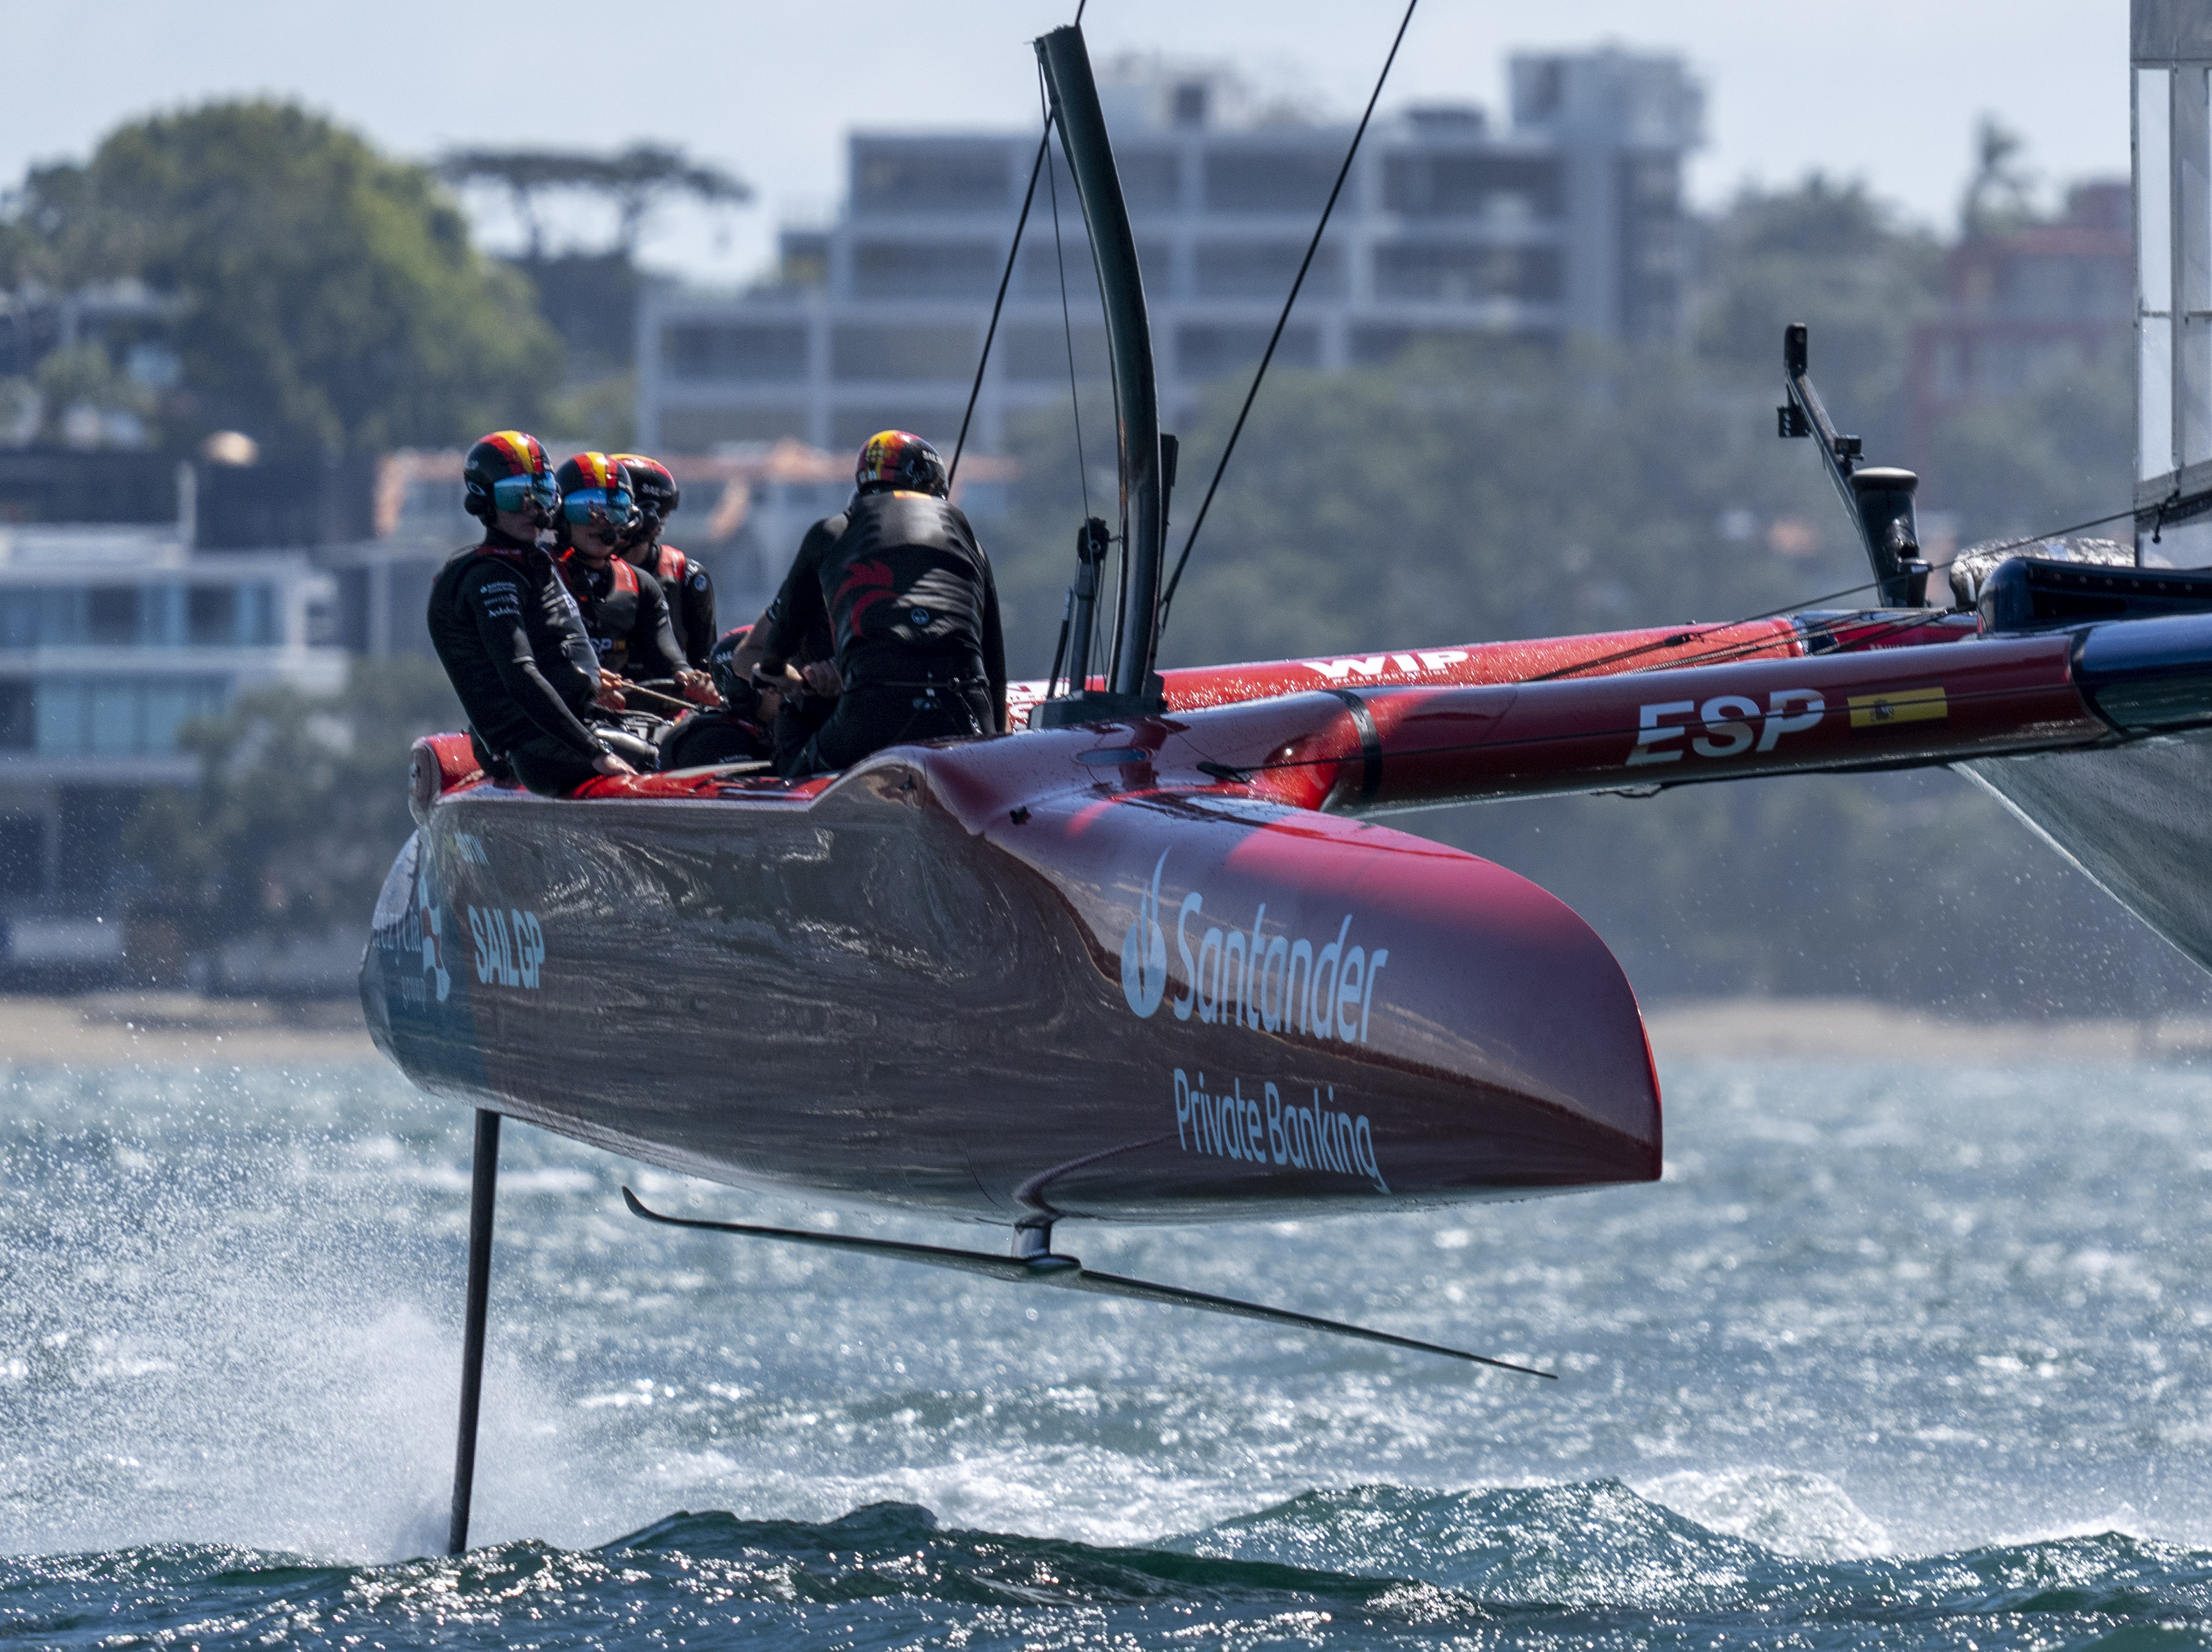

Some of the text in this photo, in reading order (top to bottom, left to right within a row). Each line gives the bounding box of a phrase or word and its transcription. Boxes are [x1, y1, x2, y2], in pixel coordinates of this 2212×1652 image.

[1301, 650, 1469, 678] WIP
[1625, 688, 1825, 766] ESP
[1173, 892, 1389, 1044] Santander
[1173, 1068, 1392, 1195] Private Banking
